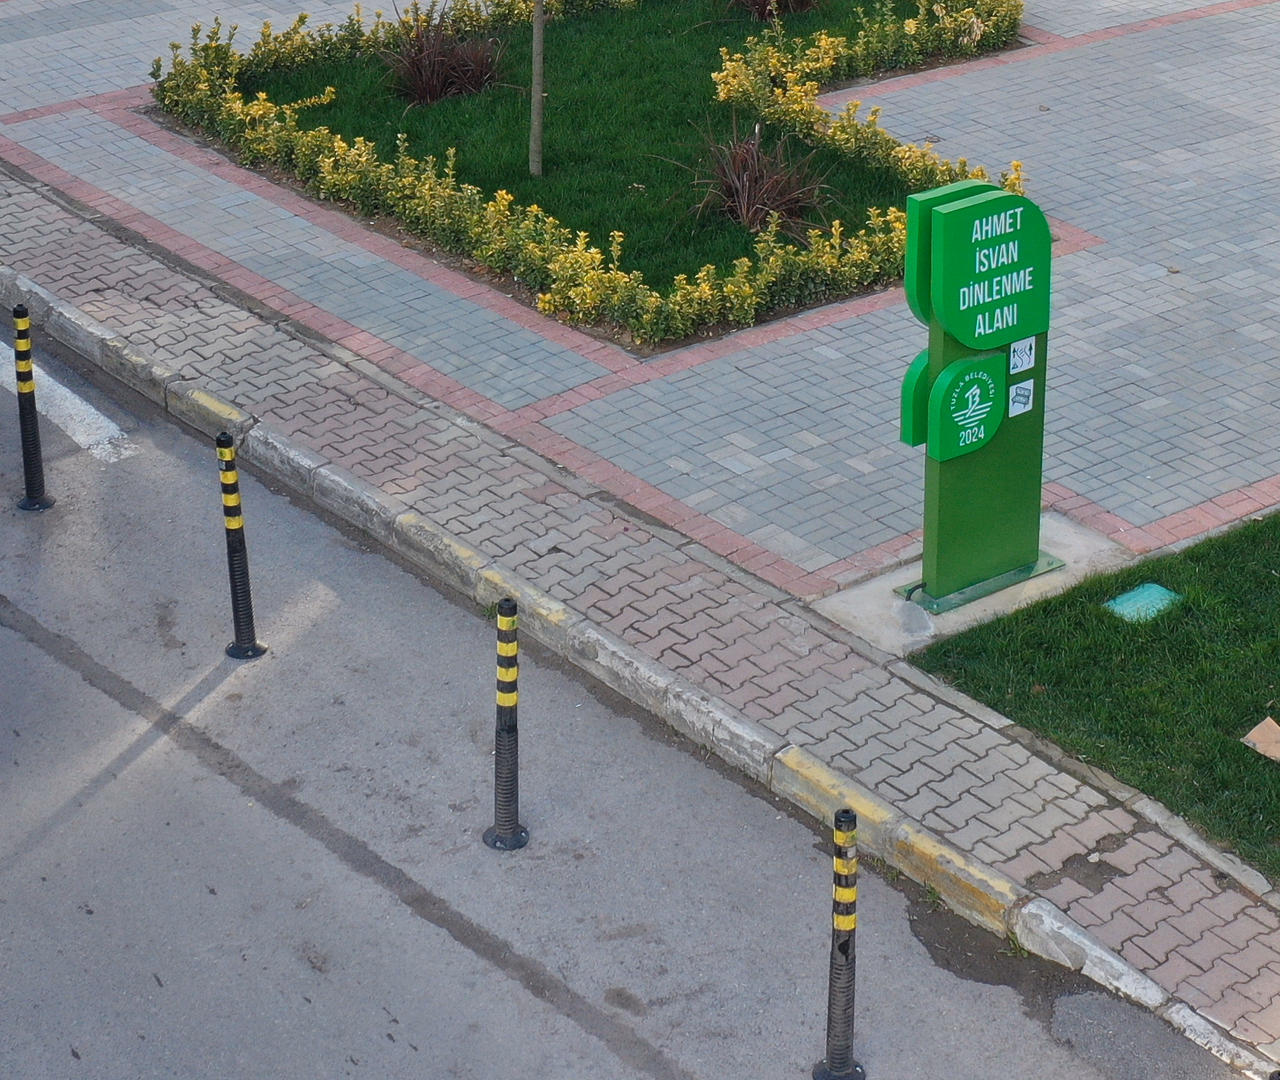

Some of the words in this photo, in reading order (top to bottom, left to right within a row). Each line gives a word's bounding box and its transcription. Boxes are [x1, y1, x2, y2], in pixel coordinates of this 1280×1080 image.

[971, 207, 1024, 243] AHMET
[975, 240, 1018, 274] İSVAN
[960, 267, 1034, 311] DİNLENME
[974, 303, 1017, 338] ALANI
[950, 381, 965, 411] TUZLA
[959, 424, 985, 447] 2024
